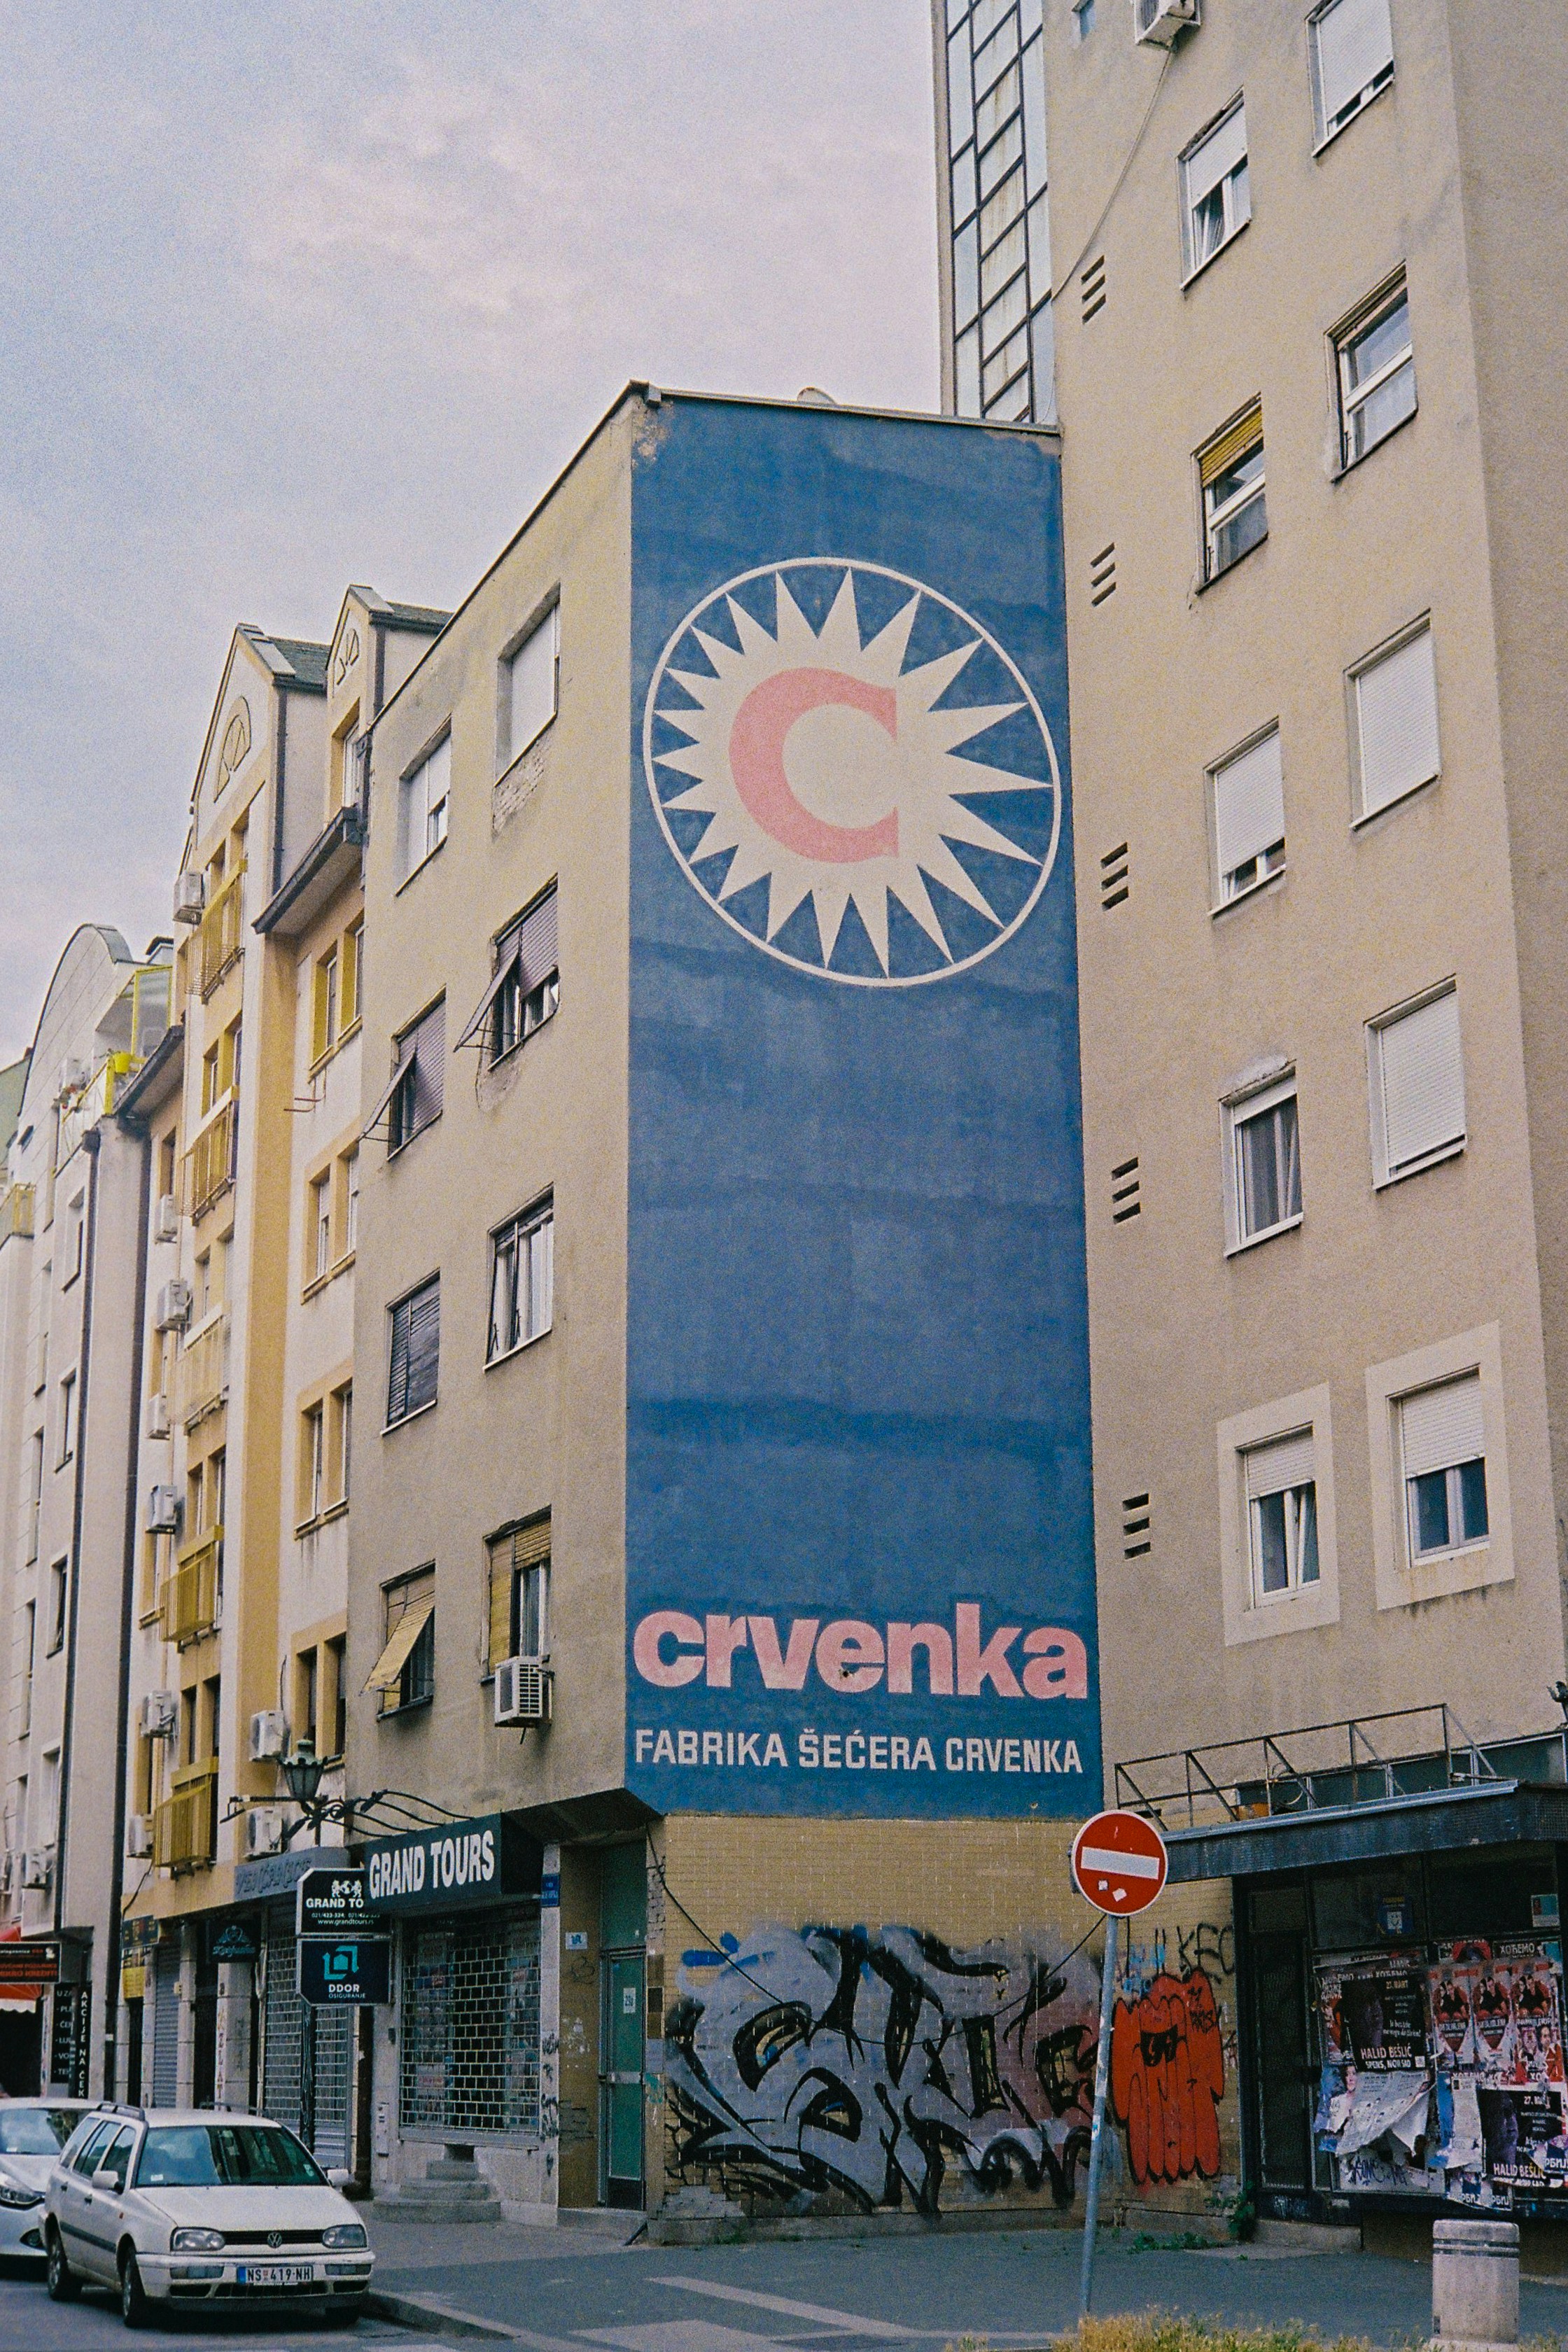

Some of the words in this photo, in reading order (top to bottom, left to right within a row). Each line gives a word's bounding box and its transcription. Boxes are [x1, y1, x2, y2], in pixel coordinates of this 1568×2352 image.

[634, 1603, 1088, 1700] crvenka
[636, 1730, 788, 1768] FABRIKA
[799, 1728, 937, 1771] ŠEĆERA
[946, 1737, 1083, 1774] CRVENKA
[370, 1845, 426, 1900] GRAND
[430, 1830, 495, 1889] TOURS
[306, 1898, 345, 1909] GRAND
[328, 1984, 360, 1993] DDOR
[80, 1991, 88, 2043] AKCIJE
[78, 2048, 86, 2065] NA
[1360, 2046, 1387, 2059] HALID
[1388, 2043, 1413, 2058] BEŠLIĆ
[77, 2069, 85, 2097] ČEK
[1493, 2162, 1518, 2176] HALID
[247, 2268, 262, 2281] NS
